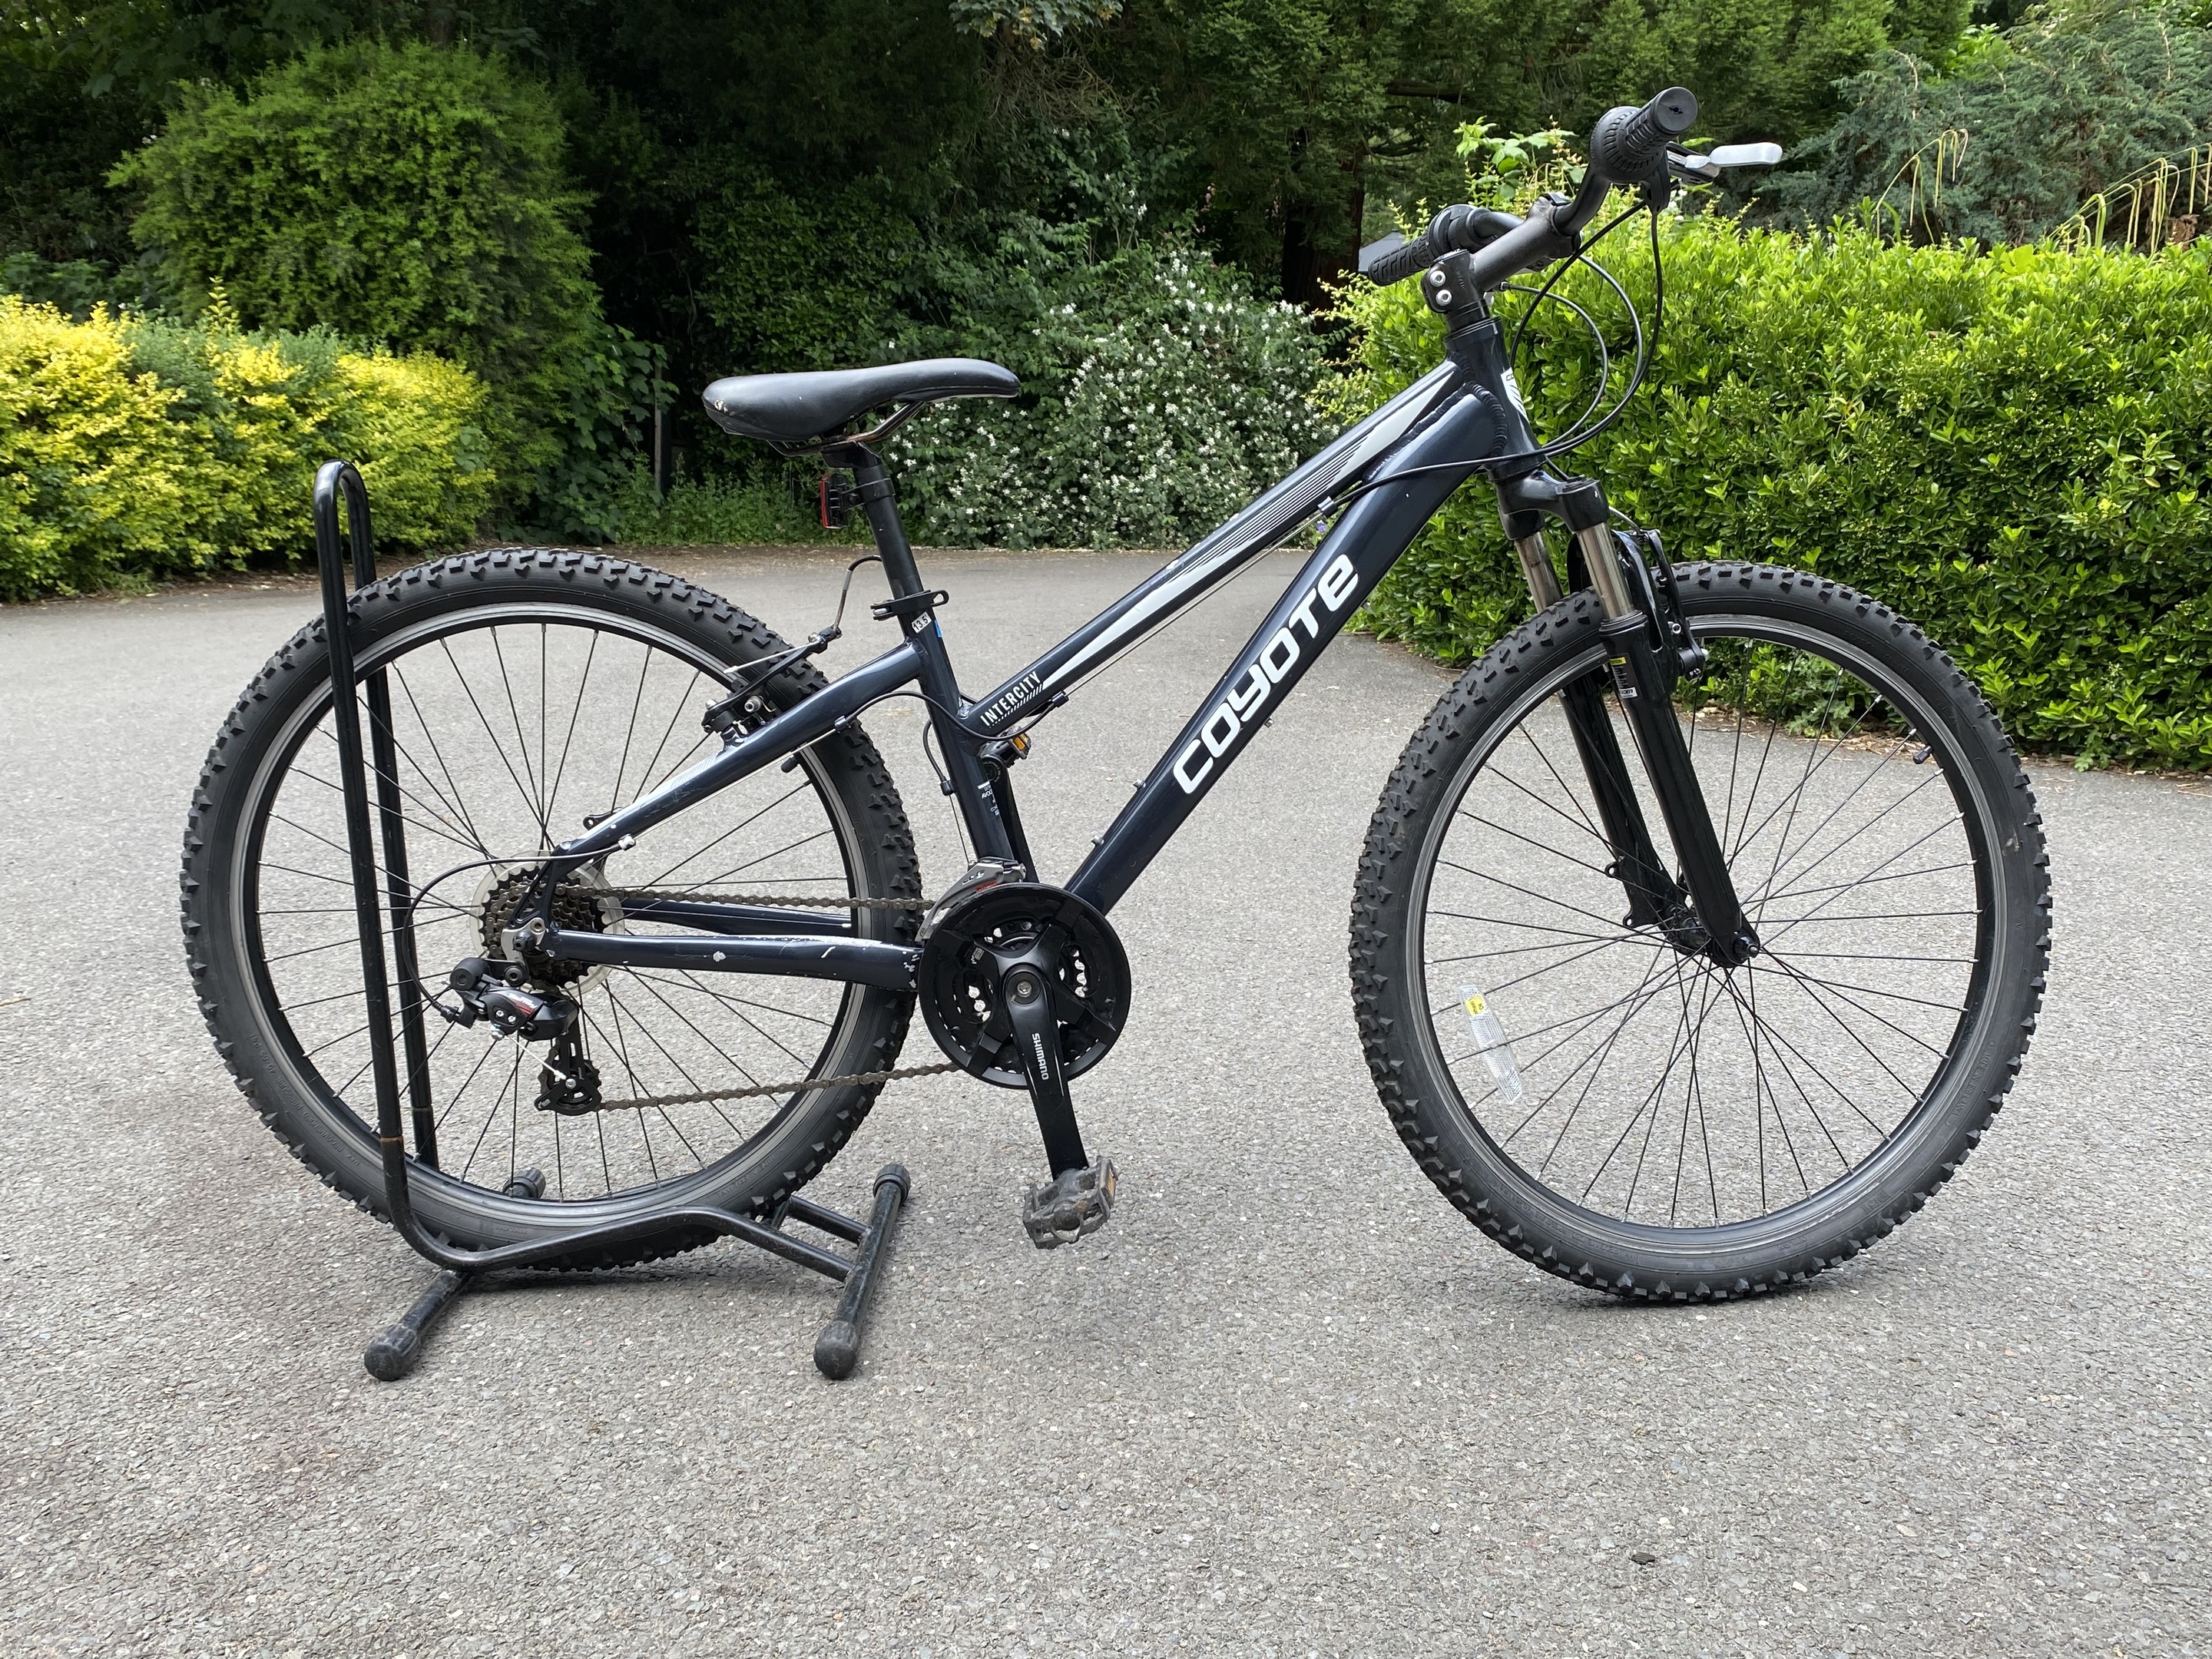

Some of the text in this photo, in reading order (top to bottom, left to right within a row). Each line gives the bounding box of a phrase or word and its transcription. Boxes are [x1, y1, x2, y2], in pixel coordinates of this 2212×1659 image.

[980, 671, 1041, 727] INTERCITY
[1174, 554, 1359, 794] COYOTE
[1031, 1032, 1049, 1081] SHIMANO
